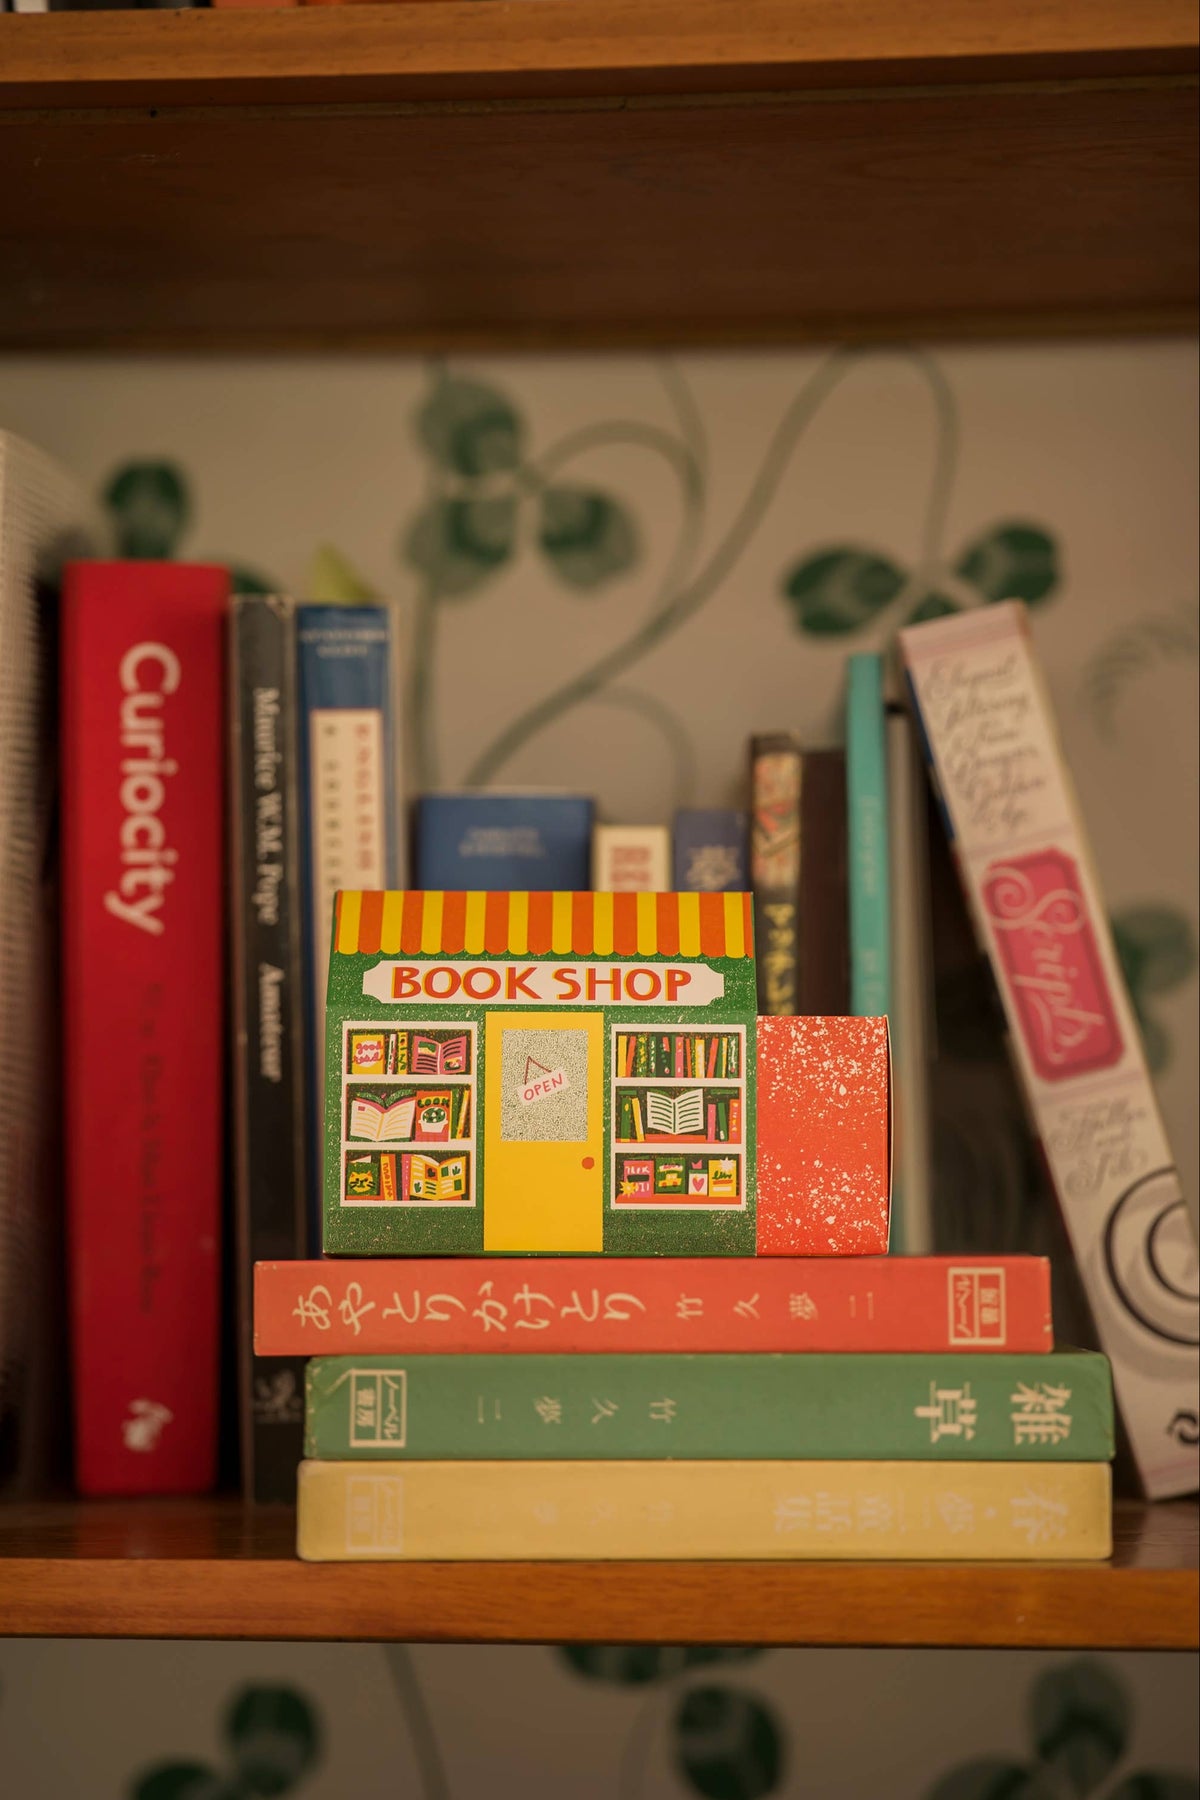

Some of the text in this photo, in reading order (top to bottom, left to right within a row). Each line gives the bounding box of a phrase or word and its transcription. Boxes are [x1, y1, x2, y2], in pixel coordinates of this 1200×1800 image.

[104, 641, 181, 935] Curiocity
[391, 966, 692, 1002] BOOK SHOP
[356, 1040, 383, 1055] good
[523, 1073, 563, 1101] OPEN
[293, 1281, 646, 1335] あやとりかけとり
[676, 1292, 875, 1321] 竹久夢二
[955, 1274, 973, 1338] ノーベル
[383, 1374, 400, 1440] ノーベル
[477, 1395, 678, 1425] 竹久夢二
[914, 1380, 1073, 1446] 雑草
